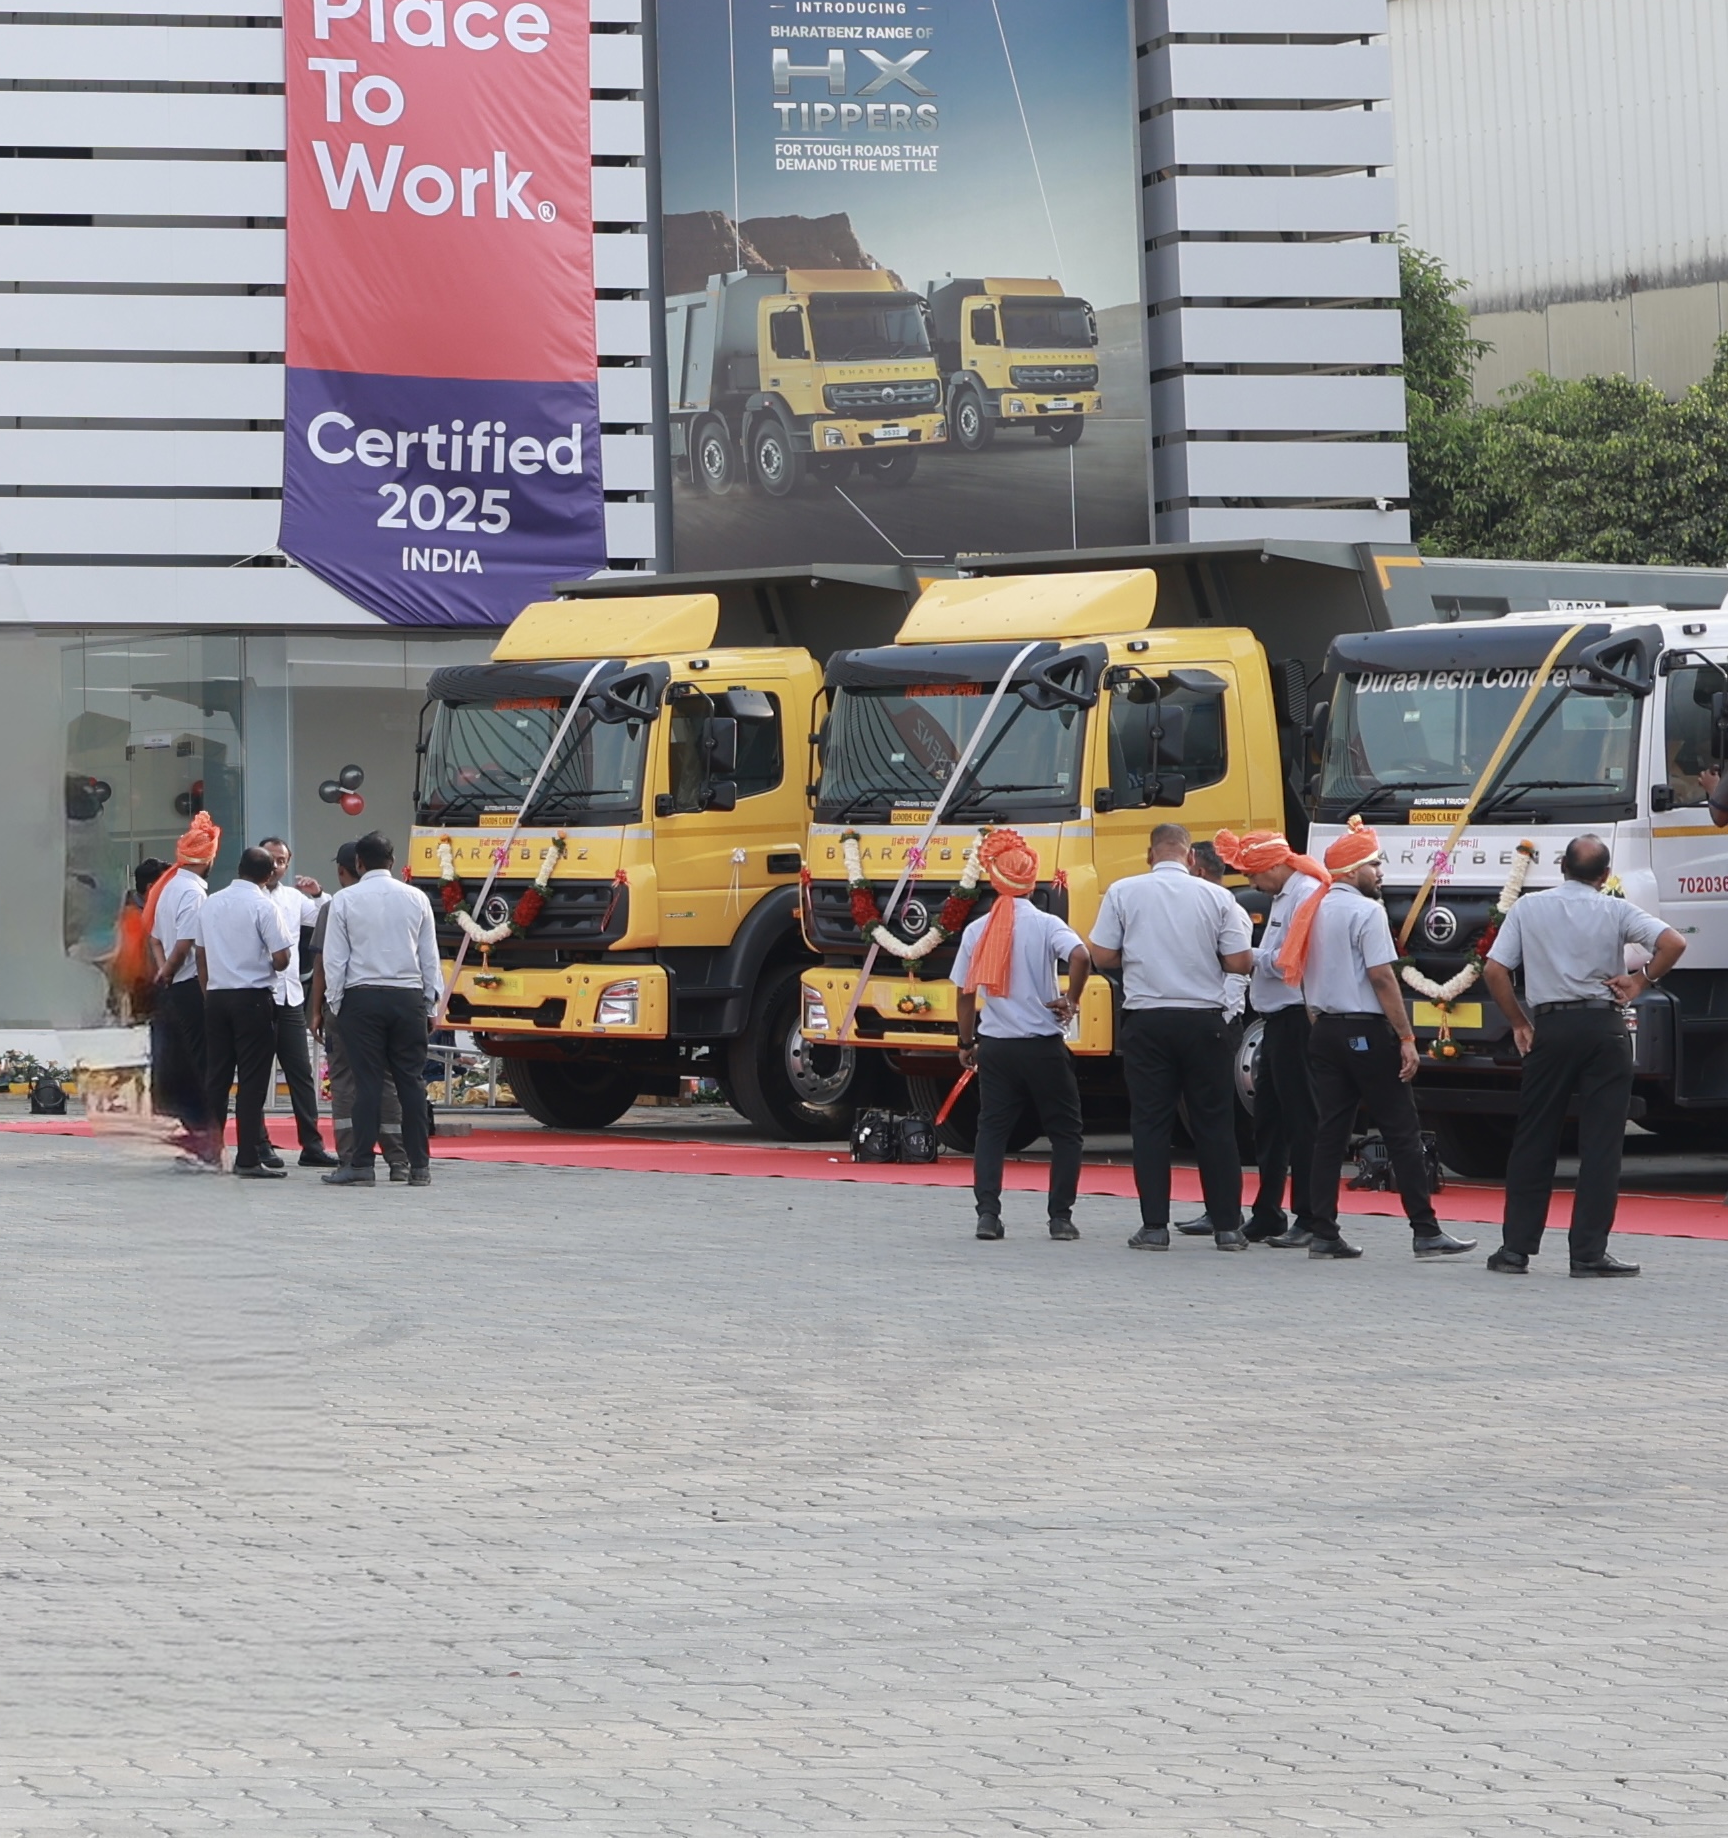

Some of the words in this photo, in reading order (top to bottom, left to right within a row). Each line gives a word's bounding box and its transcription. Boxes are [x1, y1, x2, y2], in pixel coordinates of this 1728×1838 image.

[796, 1, 906, 14] INTRODUCING
[770, 25, 863, 38] BHARATBENZ
[866, 27, 913, 39] RANGE
[915, 27, 934, 39] OF
[772, 47, 938, 97] HX
[307, 58, 405, 126] To
[772, 102, 939, 132] TIPPERS
[775, 144, 802, 156] FOR
[804, 144, 851, 156] TOUGH
[854, 145, 900, 157] ROADS
[903, 145, 939, 157] THAT
[775, 158, 837, 171] DEMAND
[840, 159, 877, 171] TRUE
[880, 159, 938, 172] METTLE
[307, 411, 584, 475] Certified
[376, 483, 512, 535] 2025
[401, 547, 483, 575] INDIA
[1482, 666, 1590, 690] Concre
[892, 813, 912, 822] GOODS
[1411, 812, 1436, 822] GOODS
